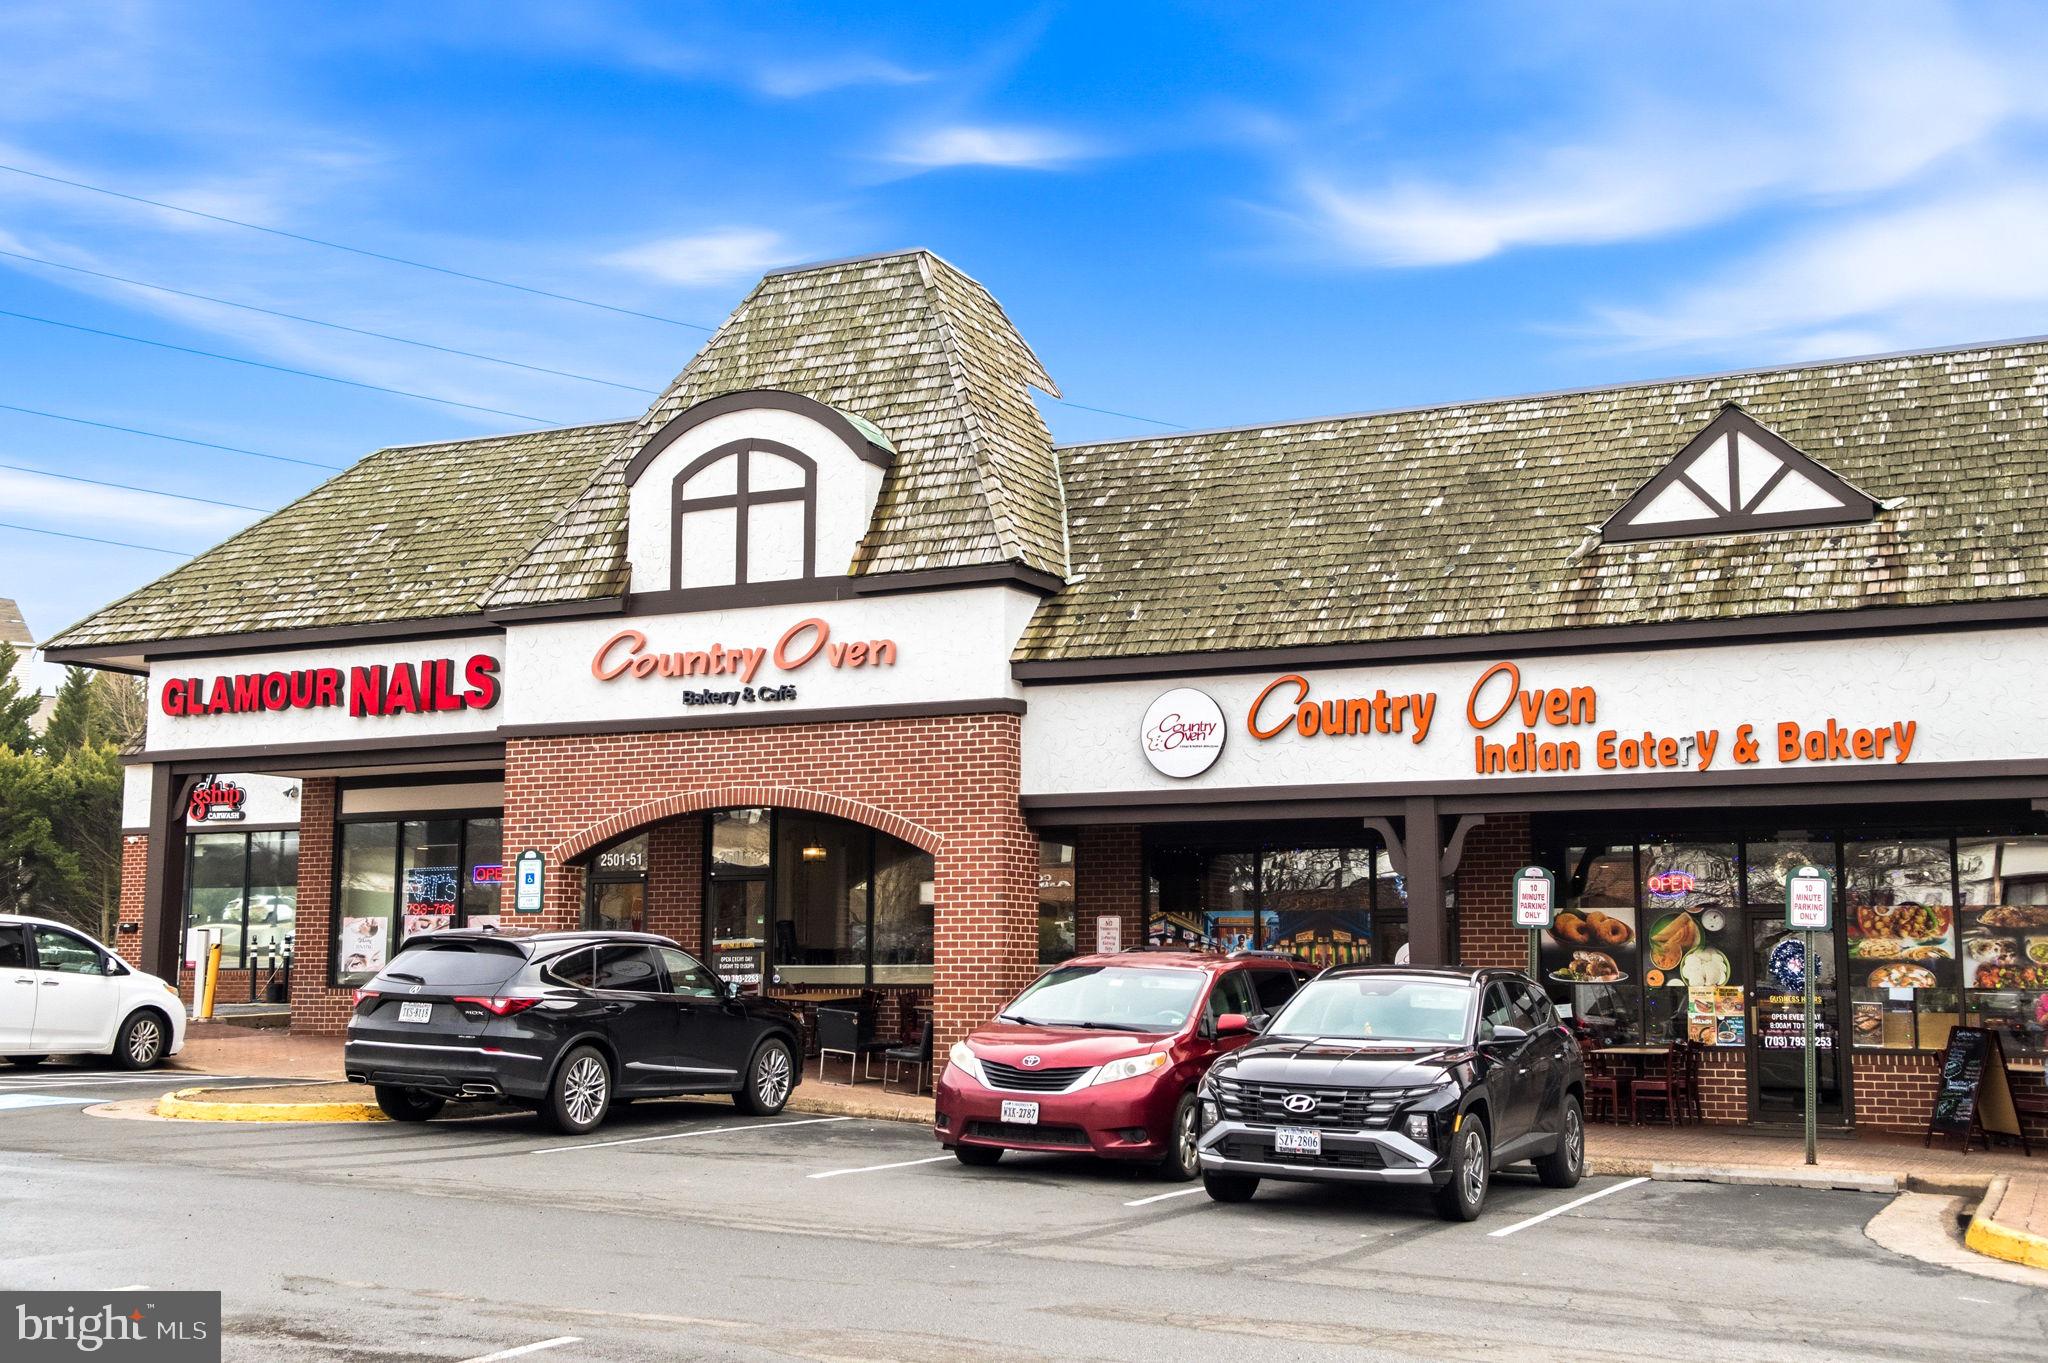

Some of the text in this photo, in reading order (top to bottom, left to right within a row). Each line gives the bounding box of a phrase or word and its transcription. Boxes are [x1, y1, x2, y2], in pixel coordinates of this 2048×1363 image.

[591, 617, 898, 683] Country Oven
[162, 654, 501, 717] GLAMOUR NAILS
[682, 684, 798, 706] Bakery & Café
[1247, 661, 1596, 744] Country Oven
[1159, 713, 1217, 735] Country
[1164, 732, 1206, 749] Oven
[1475, 718, 1916, 774] Indian Eatery & Bakery
[207, 812, 240, 820] CARWASH
[600, 853, 642, 866] 2501-51
[1530, 884, 1538, 892] 10
[1649, 876, 1694, 891] OPEN
[1805, 884, 1813, 892] 10
[1521, 893, 1545, 901] MINUTE
[1796, 893, 1822, 902] MINUTE
[407, 903, 456, 915] 793-7161
[1520, 902, 1547, 910] PARKING
[1794, 903, 1824, 911] PARKING
[1525, 911, 1542, 919] ONLY
[1800, 912, 1818, 920] ONLY
[1764, 1036, 1787, 1048] (703)
